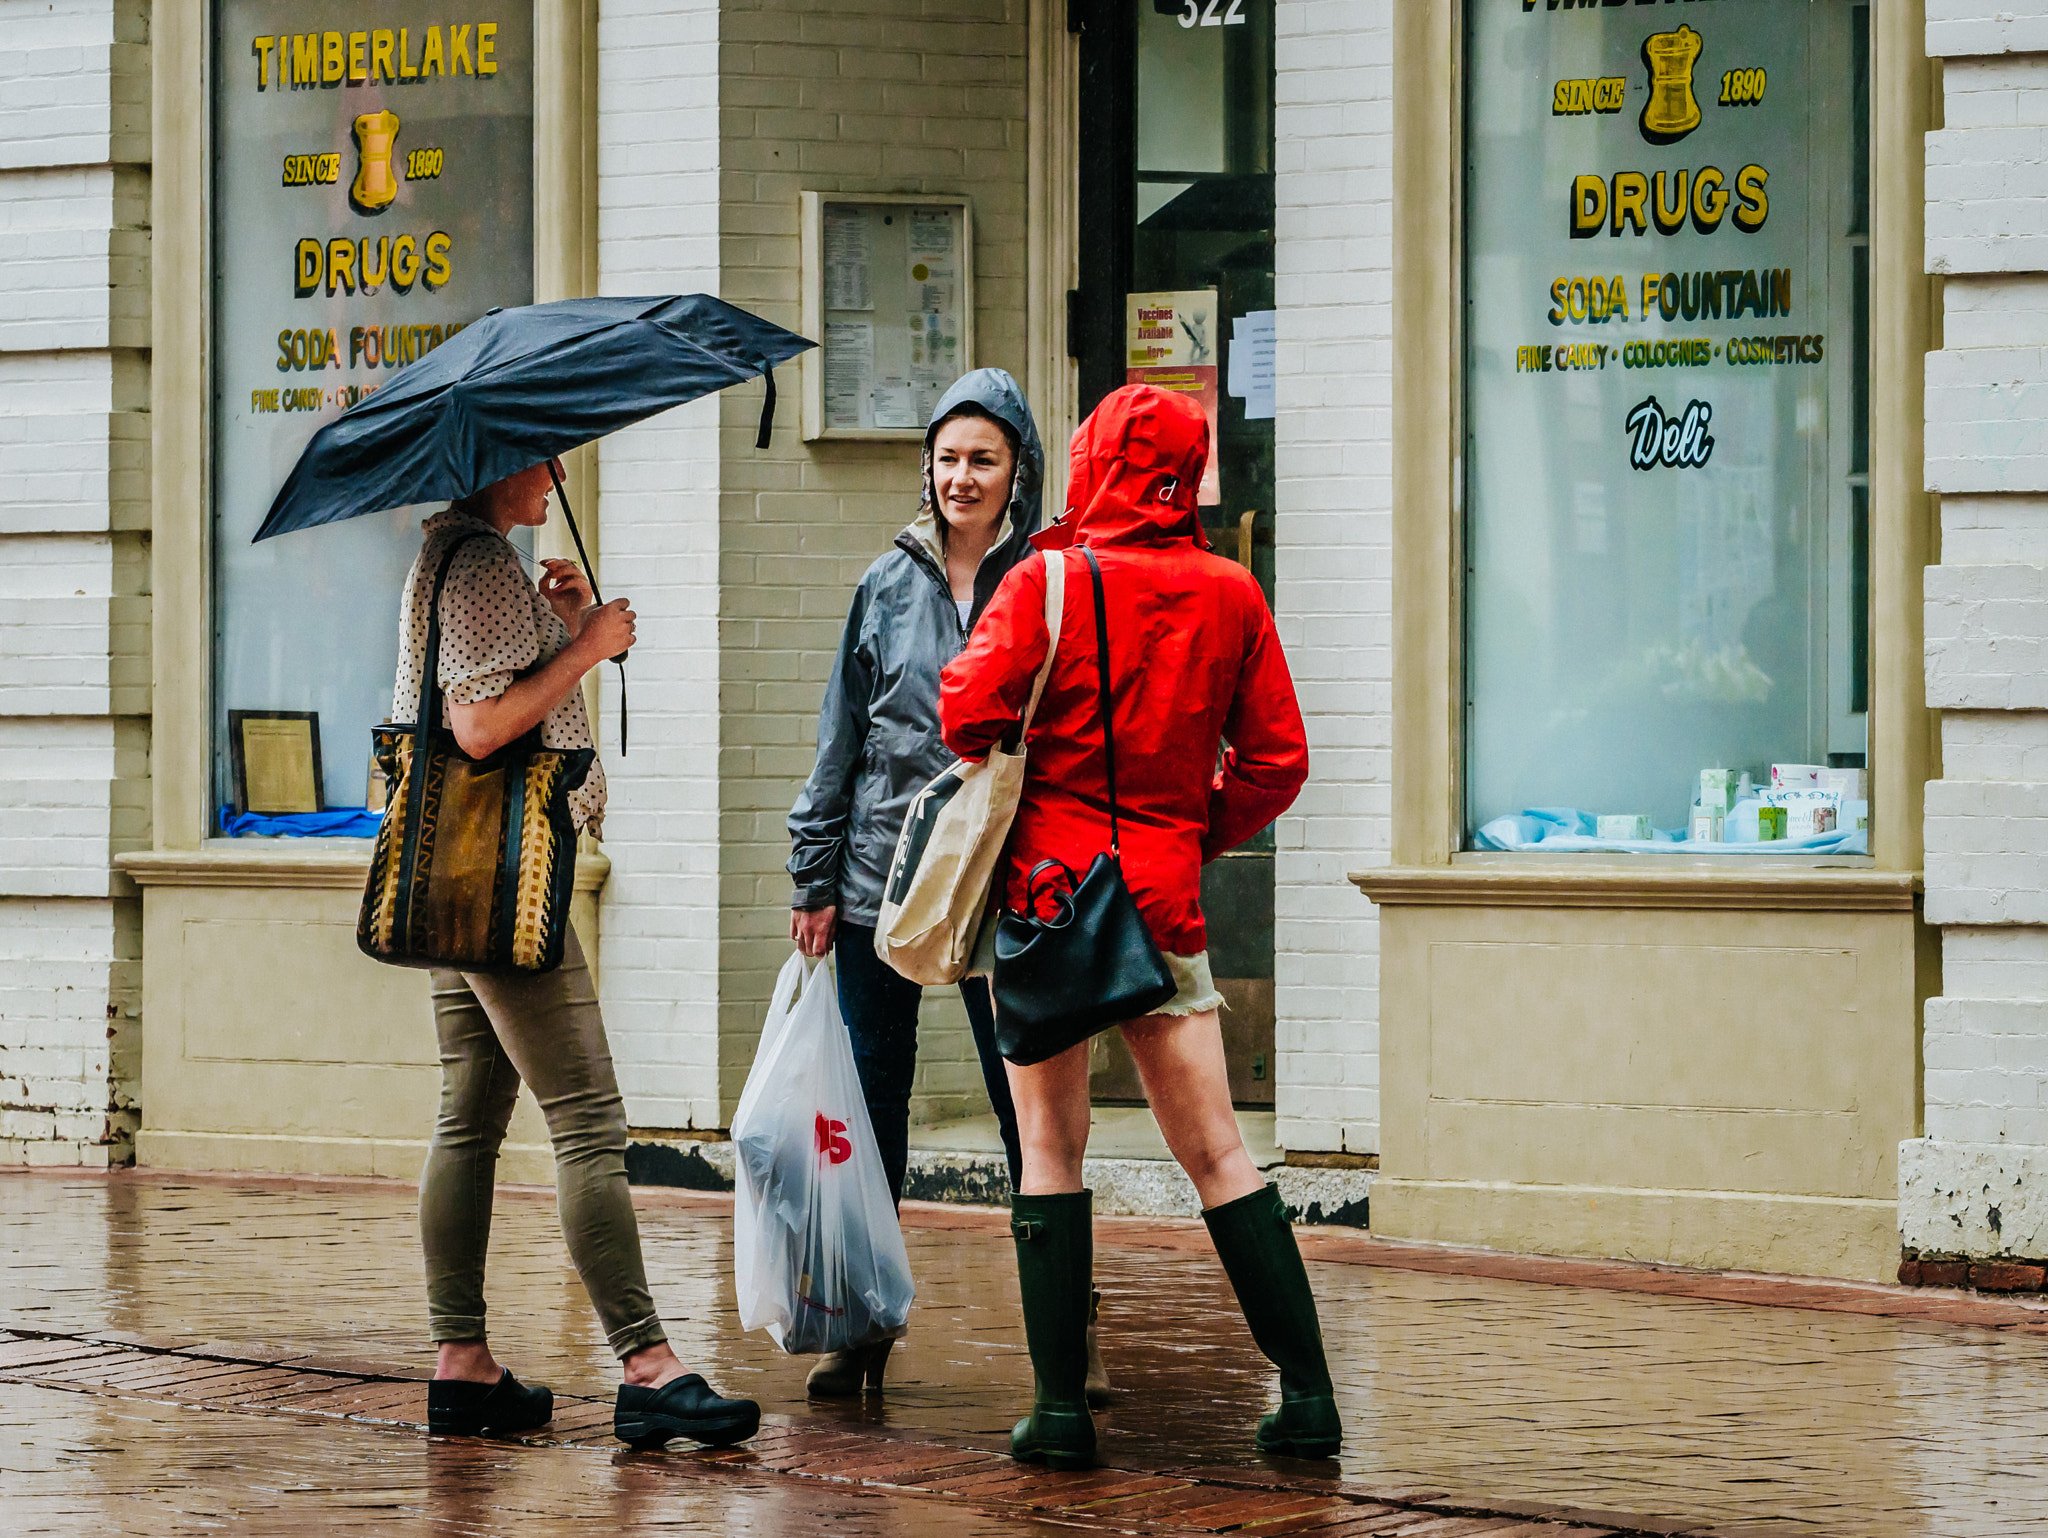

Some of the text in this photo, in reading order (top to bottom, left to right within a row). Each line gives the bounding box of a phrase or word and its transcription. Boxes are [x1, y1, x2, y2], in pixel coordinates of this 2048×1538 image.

[253, 23, 498, 91] TIMBERLAKE
[1553, 67, 1767, 116] SINCE 1890
[283, 148, 443, 187] SINCE 1890
[1570, 163, 1770, 239] DRUGS
[294, 231, 453, 298] DRUGS
[1137, 307, 1173, 321] Vaccines
[1548, 267, 1791, 326] SODA FOUNTAIN
[276, 323, 470, 372] SODA FOUNTA
[1137, 326, 1173, 340] Available
[1146, 345, 1165, 359] Here
[1517, 335, 1824, 373] FINE CANDY COLOGNES COSMETICS
[252, 389, 279, 413] FINE
[282, 387, 326, 412] CANDY
[1625, 395, 1714, 471] Deli
